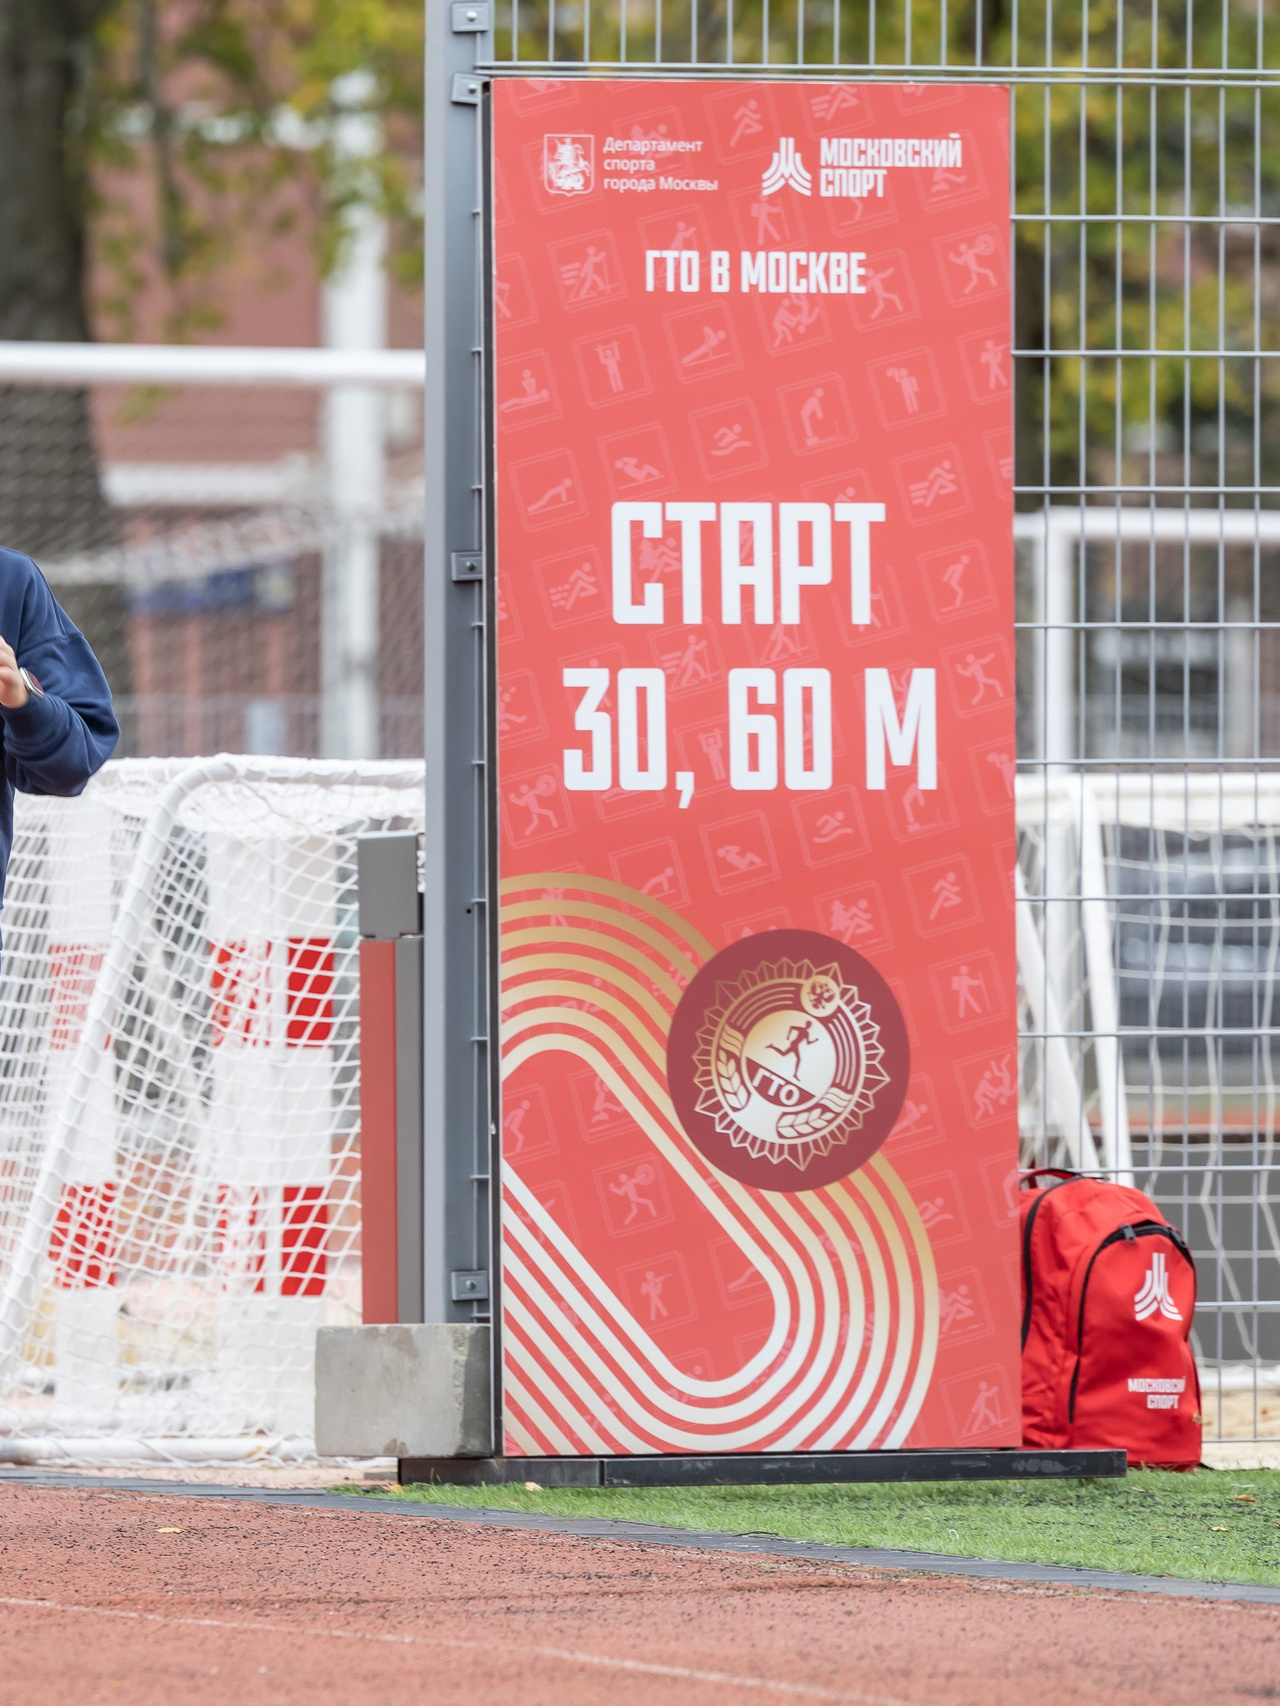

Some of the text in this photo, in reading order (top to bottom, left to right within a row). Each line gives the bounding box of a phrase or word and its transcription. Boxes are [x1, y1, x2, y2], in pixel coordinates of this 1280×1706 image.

[602, 136, 703, 154] Департамент
[820, 133, 962, 168] МОСКОВСКИЙ
[603, 158, 656, 174] спорта
[602, 176, 718, 194] города Москвы
[820, 169, 887, 197] СПОРТ
[645, 250, 867, 294] ГТО В МОСКВЕ
[611, 501, 887, 625] СТАРТ
[562, 667, 938, 809] 30, 60 М
[752, 1067, 800, 1106] ГТО
[1127, 1376, 1185, 1392] МОСКОВС
[1147, 1394, 1179, 1409] СПОРТ
